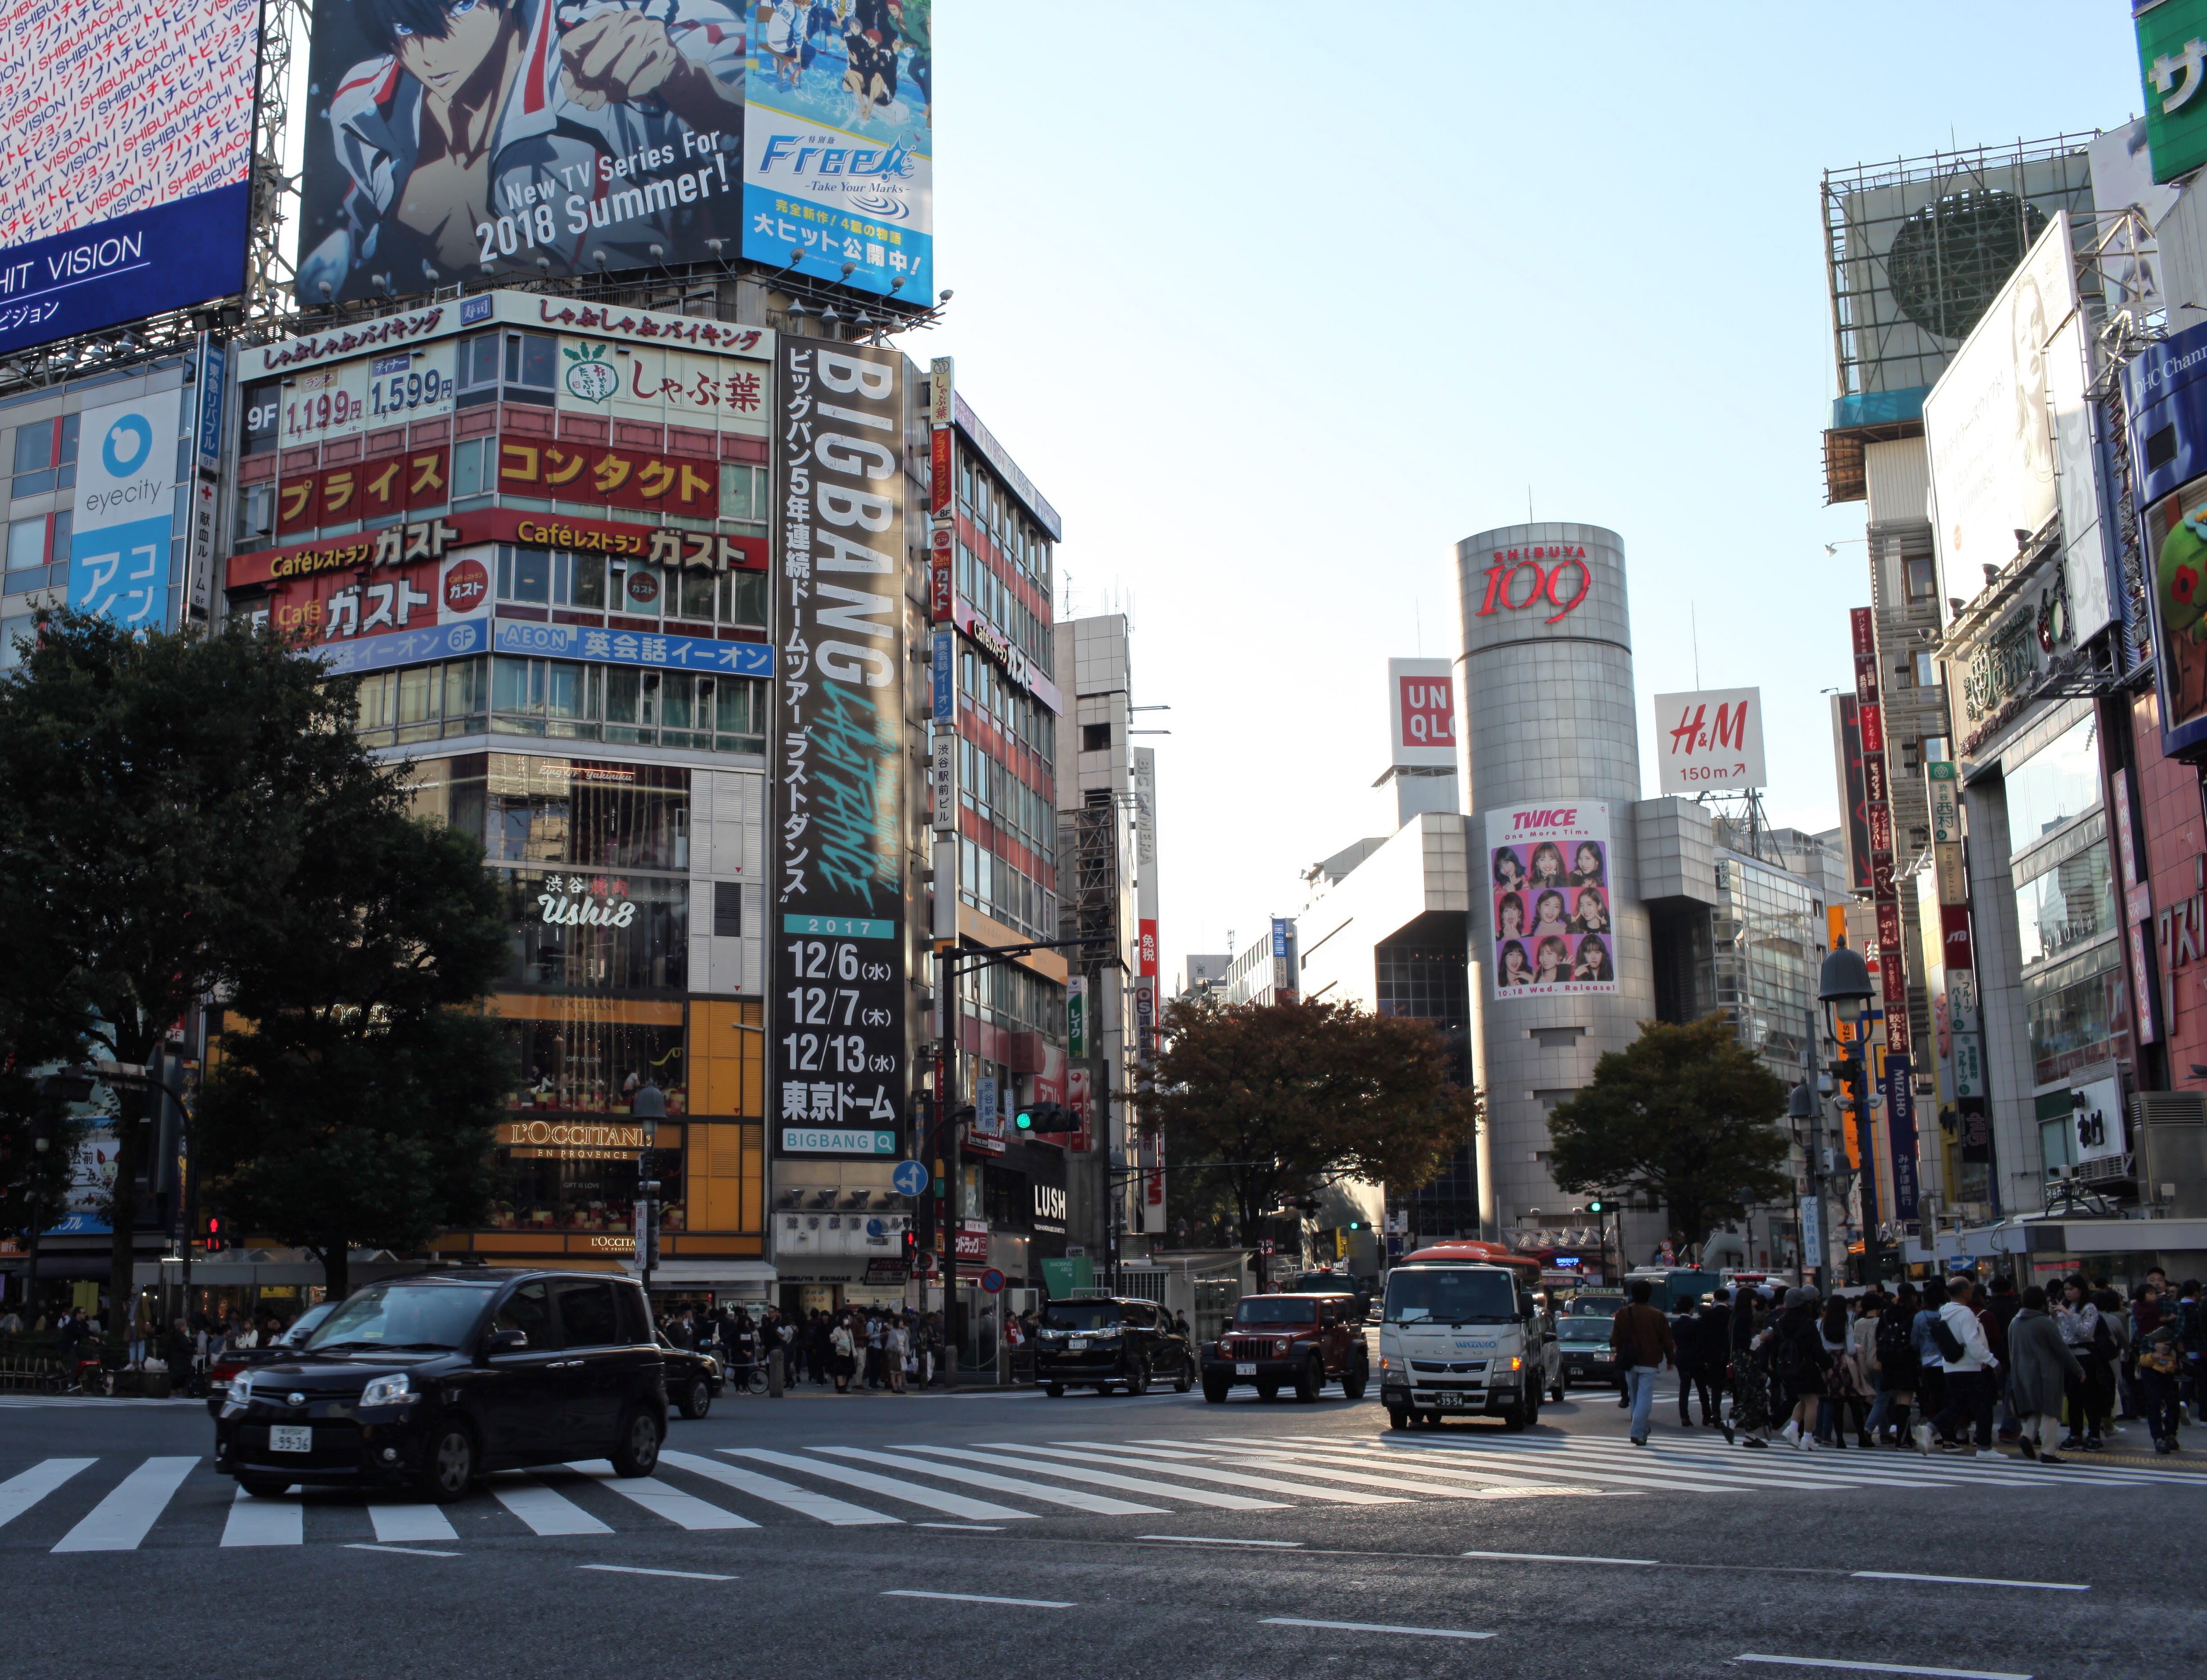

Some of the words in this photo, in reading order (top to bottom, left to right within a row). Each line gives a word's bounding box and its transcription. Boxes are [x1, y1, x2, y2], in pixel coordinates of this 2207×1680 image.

[39, 0, 123, 70] SHIBUHACHI
[56, 3, 141, 75] SHIBUHACHI
[80, 38, 168, 110] SHIBUHACHI
[174, 15, 197, 41] HIT
[98, 43, 186, 115] SHIBUHACHI
[193, 19, 216, 46] HIT
[2, 91, 49, 131] VISION
[18, 96, 66, 136] VISION
[123, 79, 213, 152] SHIBUHACHI
[220, 55, 242, 82] HIT
[142, 84, 232, 157] SHIBUHACHI
[808, 135, 836, 145] 特別版
[15, 170, 36, 196] HIT
[43, 131, 91, 172] VISION
[32, 175, 53, 201] HIT
[60, 136, 109, 178] VISION
[506, 178, 555, 210] New
[561, 161, 590, 192] TV
[599, 145, 674, 182] Series
[683, 130, 721, 159] For
[85, 173, 134, 214] VISION
[103, 179, 152, 219] VISION
[840, 182, 866, 193] Your
[475, 204, 555, 264] 2018
[565, 152, 729, 235] Summer!
[48, 231, 142, 280] VISION
[753, 213, 921, 276] 大ヒット公開中!
[464, 299, 489, 319] 寿司
[541, 299, 762, 351] しゃぶしゃぶバイキング
[263, 307, 444, 369] しゃぶしゃぶバイキング
[305, 372, 334, 389] ランチ
[375, 358, 407, 373] ディナー
[2134, 368, 2161, 400] DHC
[632, 360, 761, 414] しゃぶ葉
[936, 376, 947, 419] しゃぶ葉
[204, 362, 220, 451] 東急リバブル
[247, 403, 278, 431] 9F
[204, 456, 214, 467] 9F
[936, 432, 945, 462] プライス
[281, 454, 443, 521] プライス
[501, 444, 710, 503] コンタクト
[87, 478, 162, 515] eyecity
[940, 509, 951, 517] 8F
[815, 349, 896, 687] BIGBANG
[196, 511, 210, 592] 献血ルーム
[373, 518, 457, 568] ガスト
[649, 528, 745, 570] ガスト
[1493, 545, 1586, 563] SHIBUYA
[196, 596, 205, 605] 6F
[449, 582, 483, 599] ガスト
[631, 584, 655, 594] ガスト
[936, 567, 949, 611] ガスト
[1475, 559, 1591, 624] 109
[278, 600, 321, 626] Café
[325, 580, 428, 638] ガスト
[451, 630, 472, 645] 6F
[504, 628, 567, 649] AEON
[585, 631, 768, 669] 英会話イーオン
[938, 641, 948, 715] 英会話イーオン
[1007, 645, 1033, 691] ガスト
[1408, 685, 1447, 709] UN
[1670, 701, 1748, 756] H&M
[938, 744, 949, 822] 渋谷駅前ビル
[1138, 757, 1150, 787] BIC
[1680, 768, 1728, 782] 150m
[1512, 808, 1577, 831] TWICE
[1530, 829, 1557, 837] More
[1871, 811, 1881, 850] タージマハール
[1881, 811, 1890, 850] インド料理店
[2117, 779, 2134, 882] お好み焼
[1945, 847, 1955, 893] Euphoria
[537, 893, 636, 928] Ushi8
[808, 919, 870, 935] 2017
[1274, 924, 1283, 934] THE
[1142, 934, 1155, 961] 免税
[1274, 936, 1284, 955] PRIME
[1880, 919, 1893, 945] 卵と私
[1946, 929, 1968, 943] JTB
[1497, 988, 1523, 997] 10.18
[1529, 985, 1557, 994] Wed.
[1565, 983, 1615, 992] Release!
[1952, 987, 1961, 1018] パーラー
[1962, 981, 1972, 1013] フルーツ
[1070, 1009, 1080, 1038] レイク
[1888, 1013, 1902, 1050] 餃子屋台
[1957, 1050, 1967, 1082] フルーツ
[1967, 1046, 1978, 1079] 渋谷西村
[782, 1080, 896, 1121] 東京ドーム
[984, 1082, 994, 1128] 渋谷駅前
[1893, 1069, 1907, 1117] MIZUHO
[511, 1120, 652, 1146] L'OCCITANE
[787, 1133, 869, 1149] BIGBANG
[1966, 1112, 1987, 1146] HUB
[537, 1149, 553, 1157] EN
[561, 1150, 628, 1159] PROVENCE
[1898, 1154, 1911, 1206] みずほ銀行
[1034, 1185, 1066, 1220] LUSH
[1804, 1204, 1816, 1255] 文化村通り
[1441, 1398, 1462, 1406] 39-54
